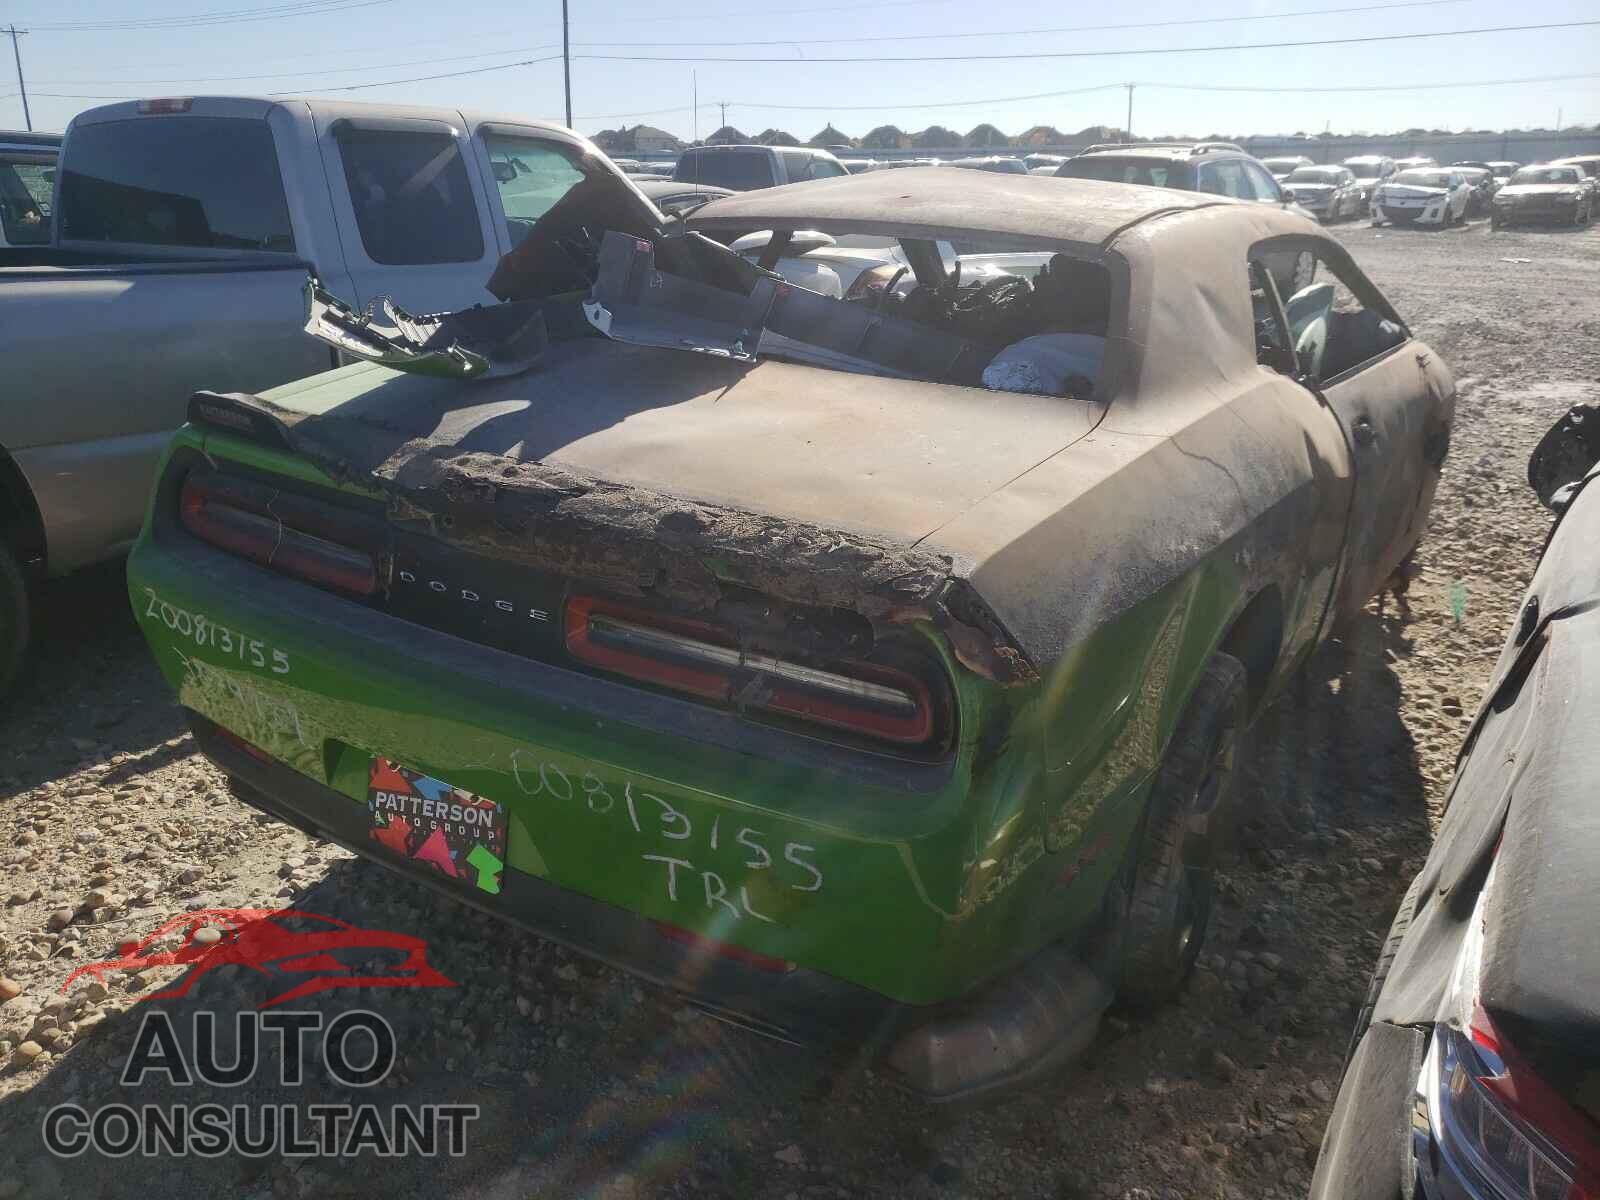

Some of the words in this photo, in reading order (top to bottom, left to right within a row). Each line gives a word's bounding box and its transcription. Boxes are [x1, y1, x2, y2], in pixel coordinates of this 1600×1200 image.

[400, 571, 550, 622] DODGE
[143, 585, 290, 674] 200813155
[374, 811, 421, 827] AUTO
[430, 821, 496, 841] GROUP
[375, 791, 493, 828] PATTERSON
[641, 854, 777, 924] TRL
